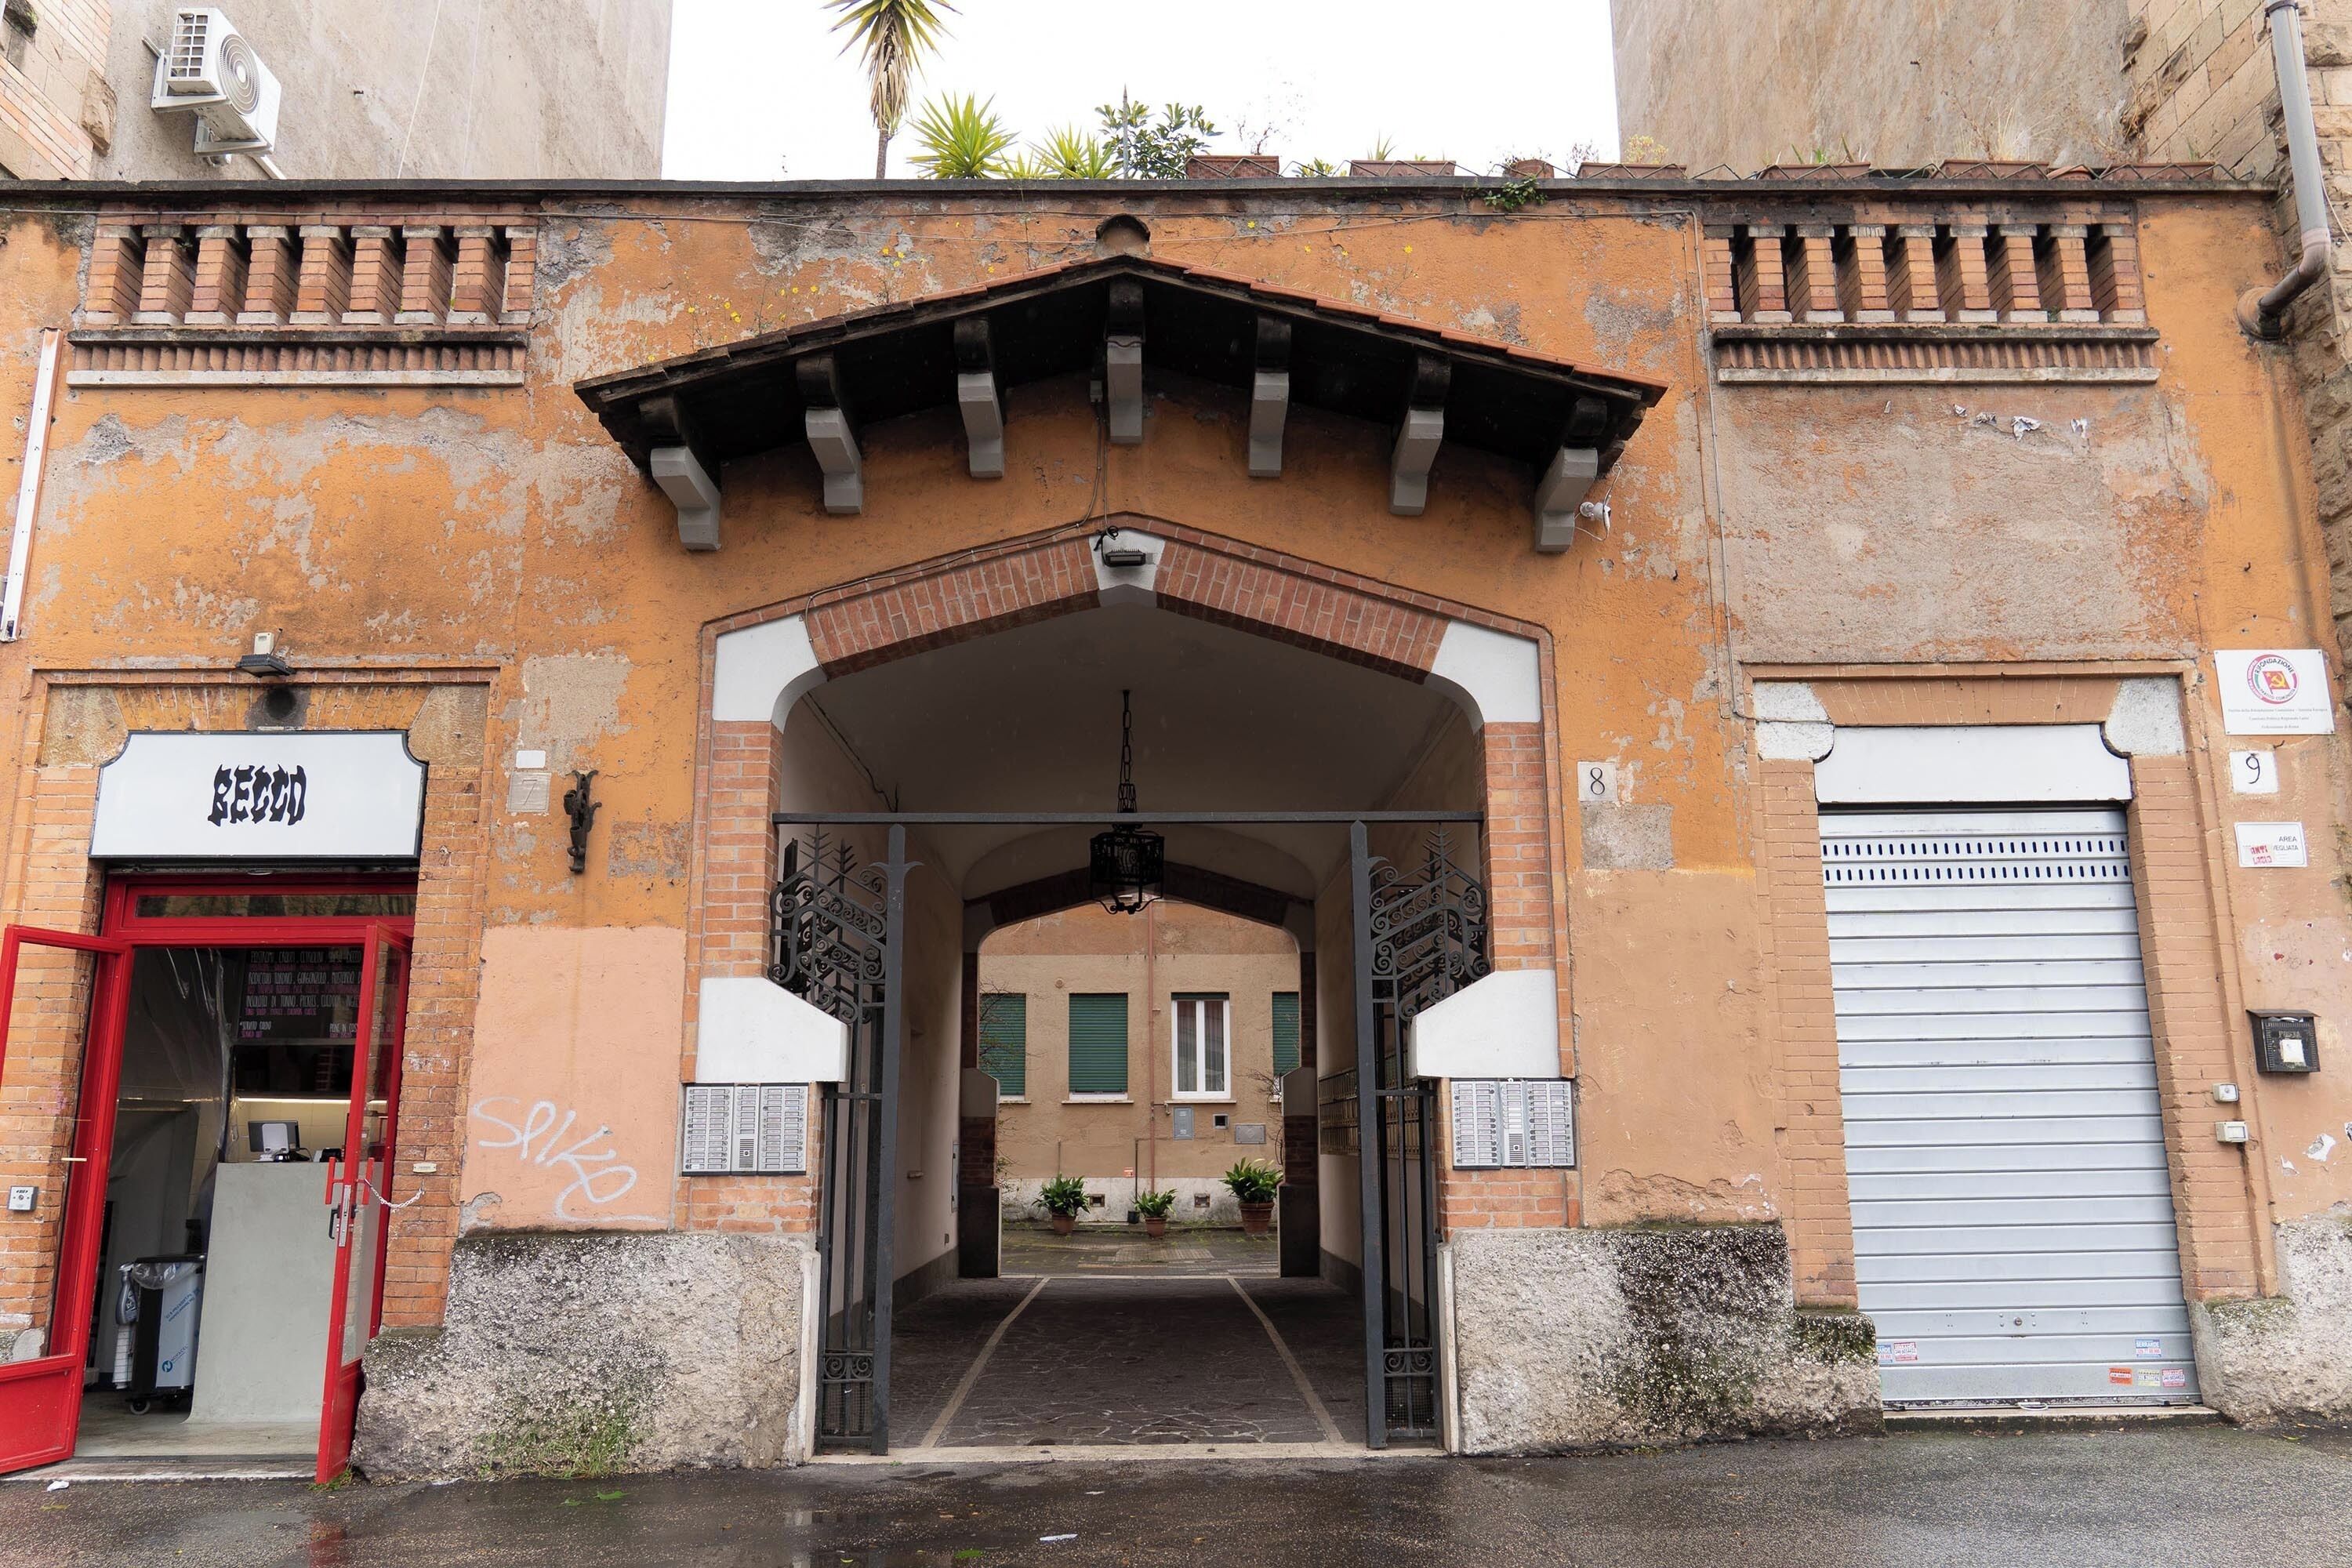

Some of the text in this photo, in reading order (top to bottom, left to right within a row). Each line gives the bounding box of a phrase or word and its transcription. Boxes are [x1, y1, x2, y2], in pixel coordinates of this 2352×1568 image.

[2254, 658, 2294, 673] RIFONDAZIONE
[1590, 767, 1606, 796] 8
[2245, 753, 2261, 785] 9
[207, 764, 307, 827] BECCO
[521, 779, 538, 806] 7
[2251, 845, 2268, 855] ANTI
